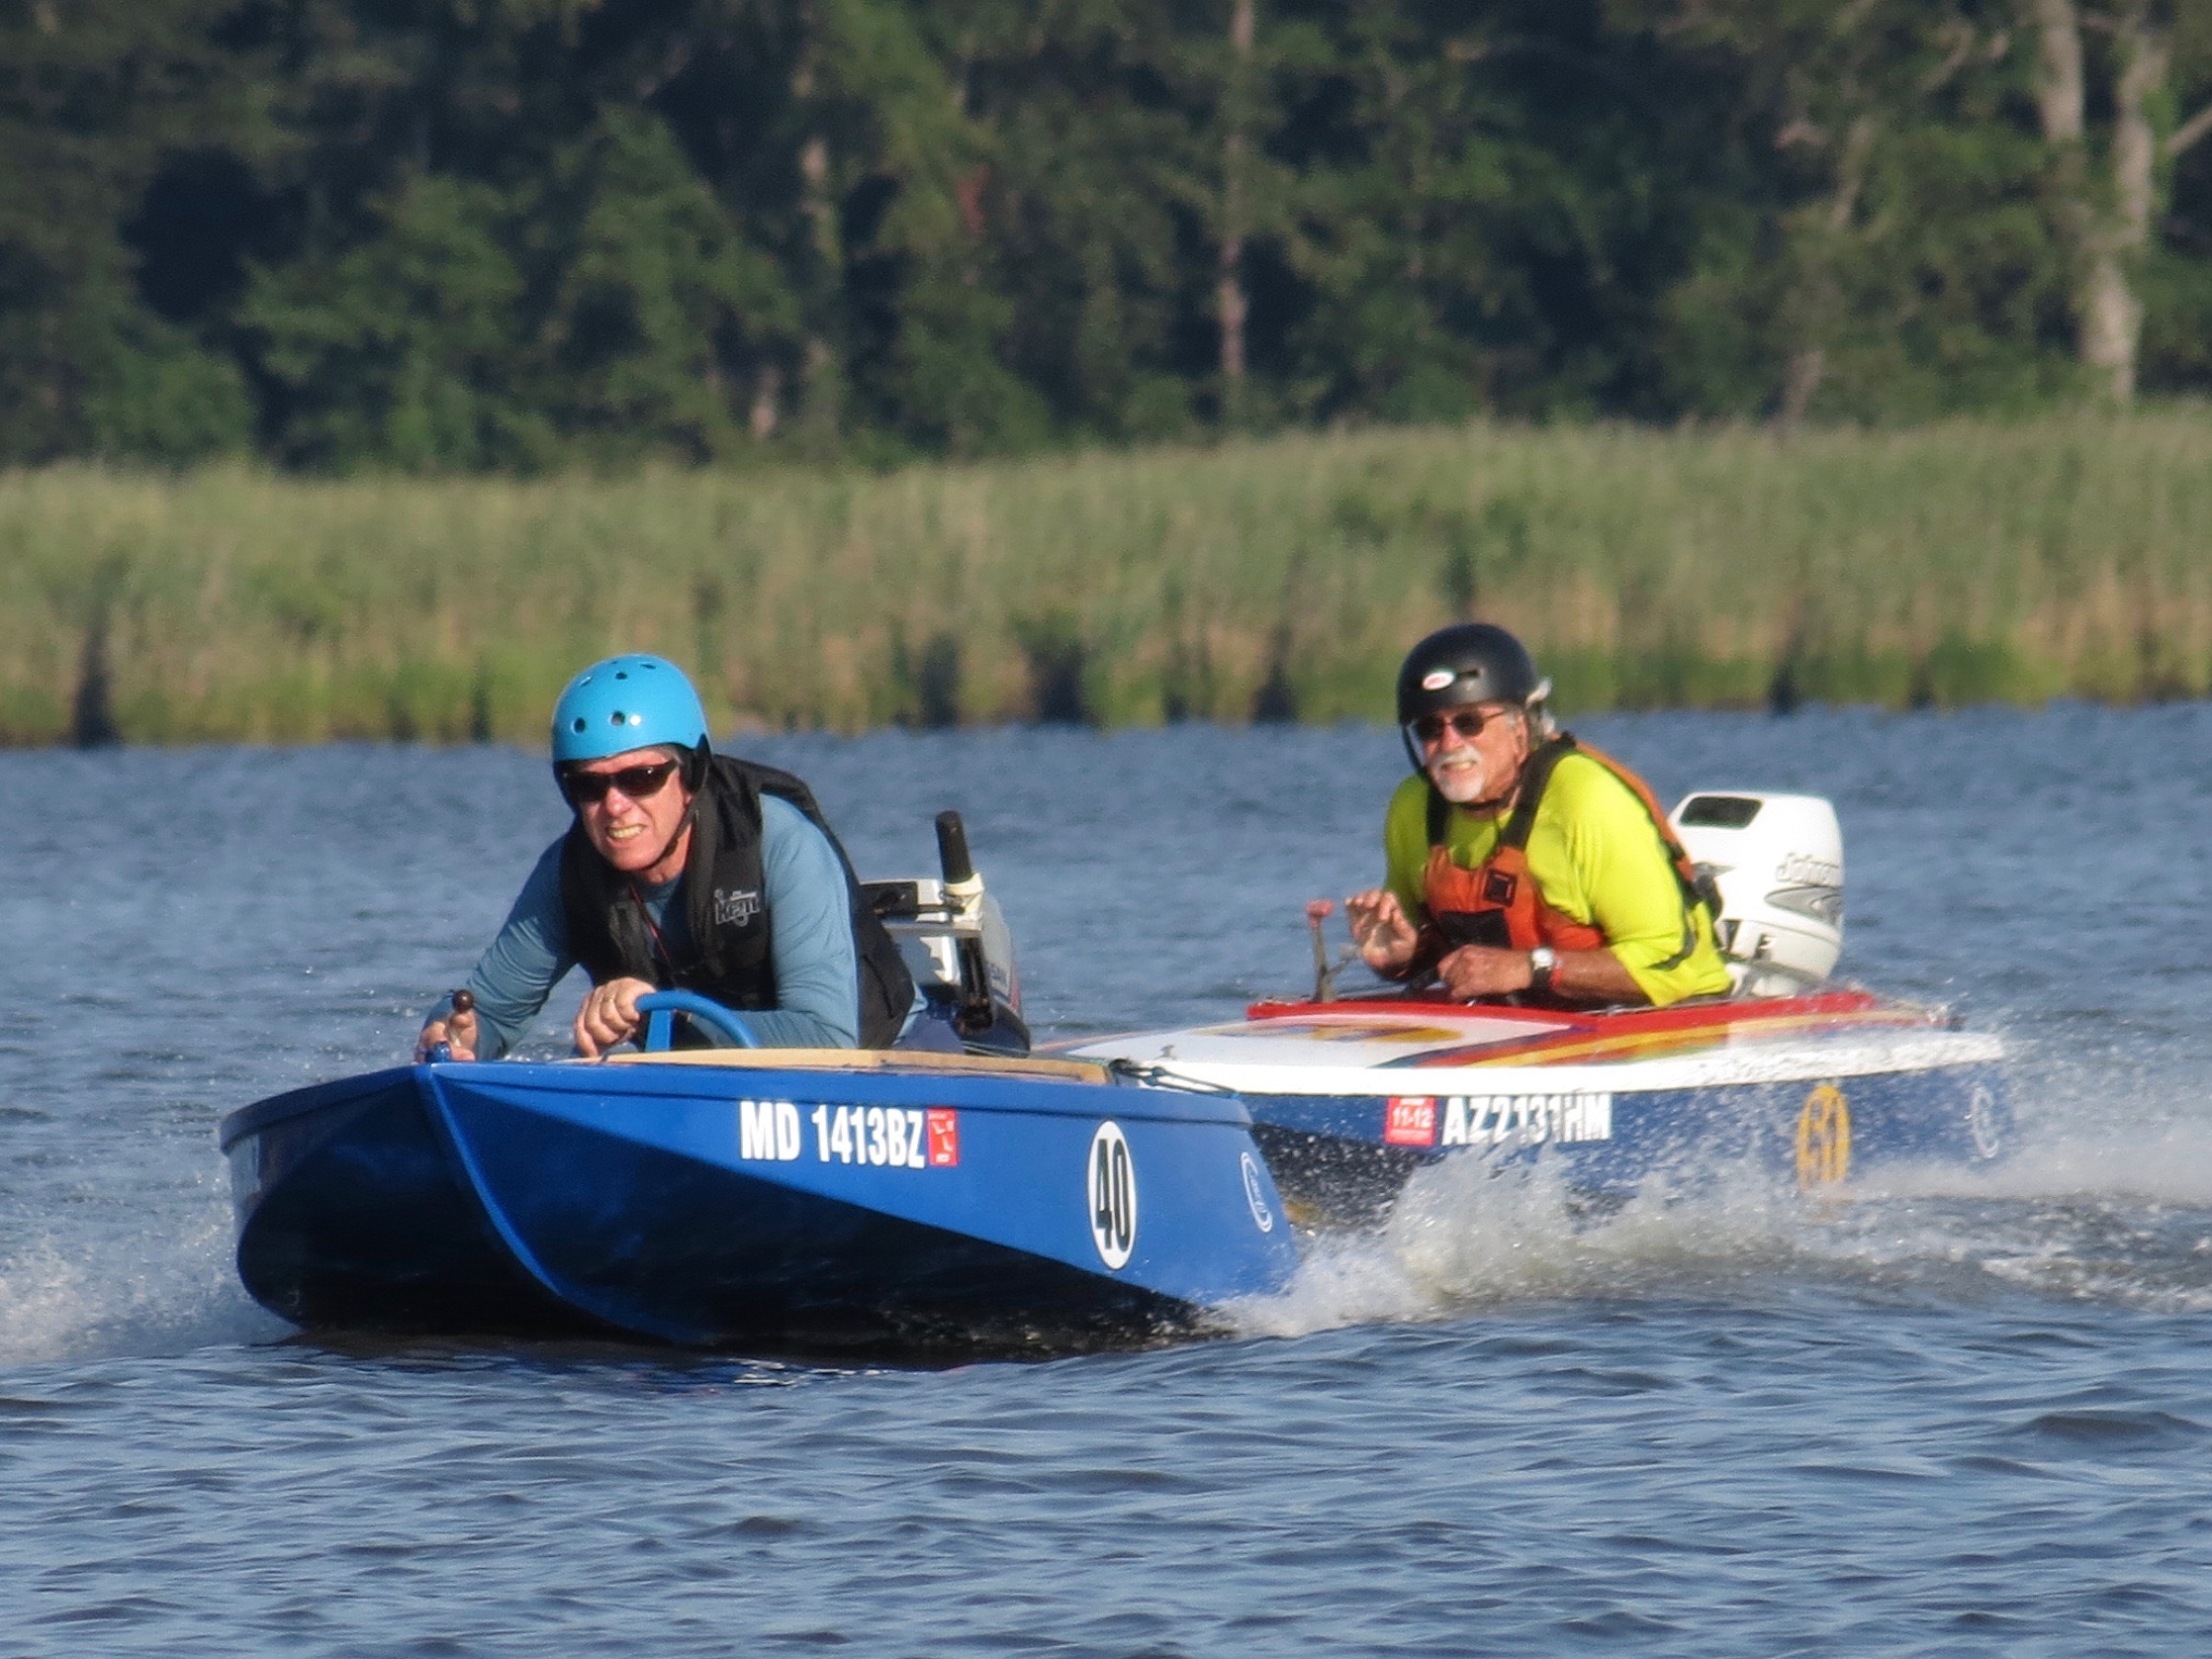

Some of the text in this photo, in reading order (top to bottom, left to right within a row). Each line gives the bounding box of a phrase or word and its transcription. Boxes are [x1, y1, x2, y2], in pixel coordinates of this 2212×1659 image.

[740, 1100, 801, 1161] MD
[811, 1104, 926, 1168] 1413BZ
[1095, 1138, 1132, 1252] 40
